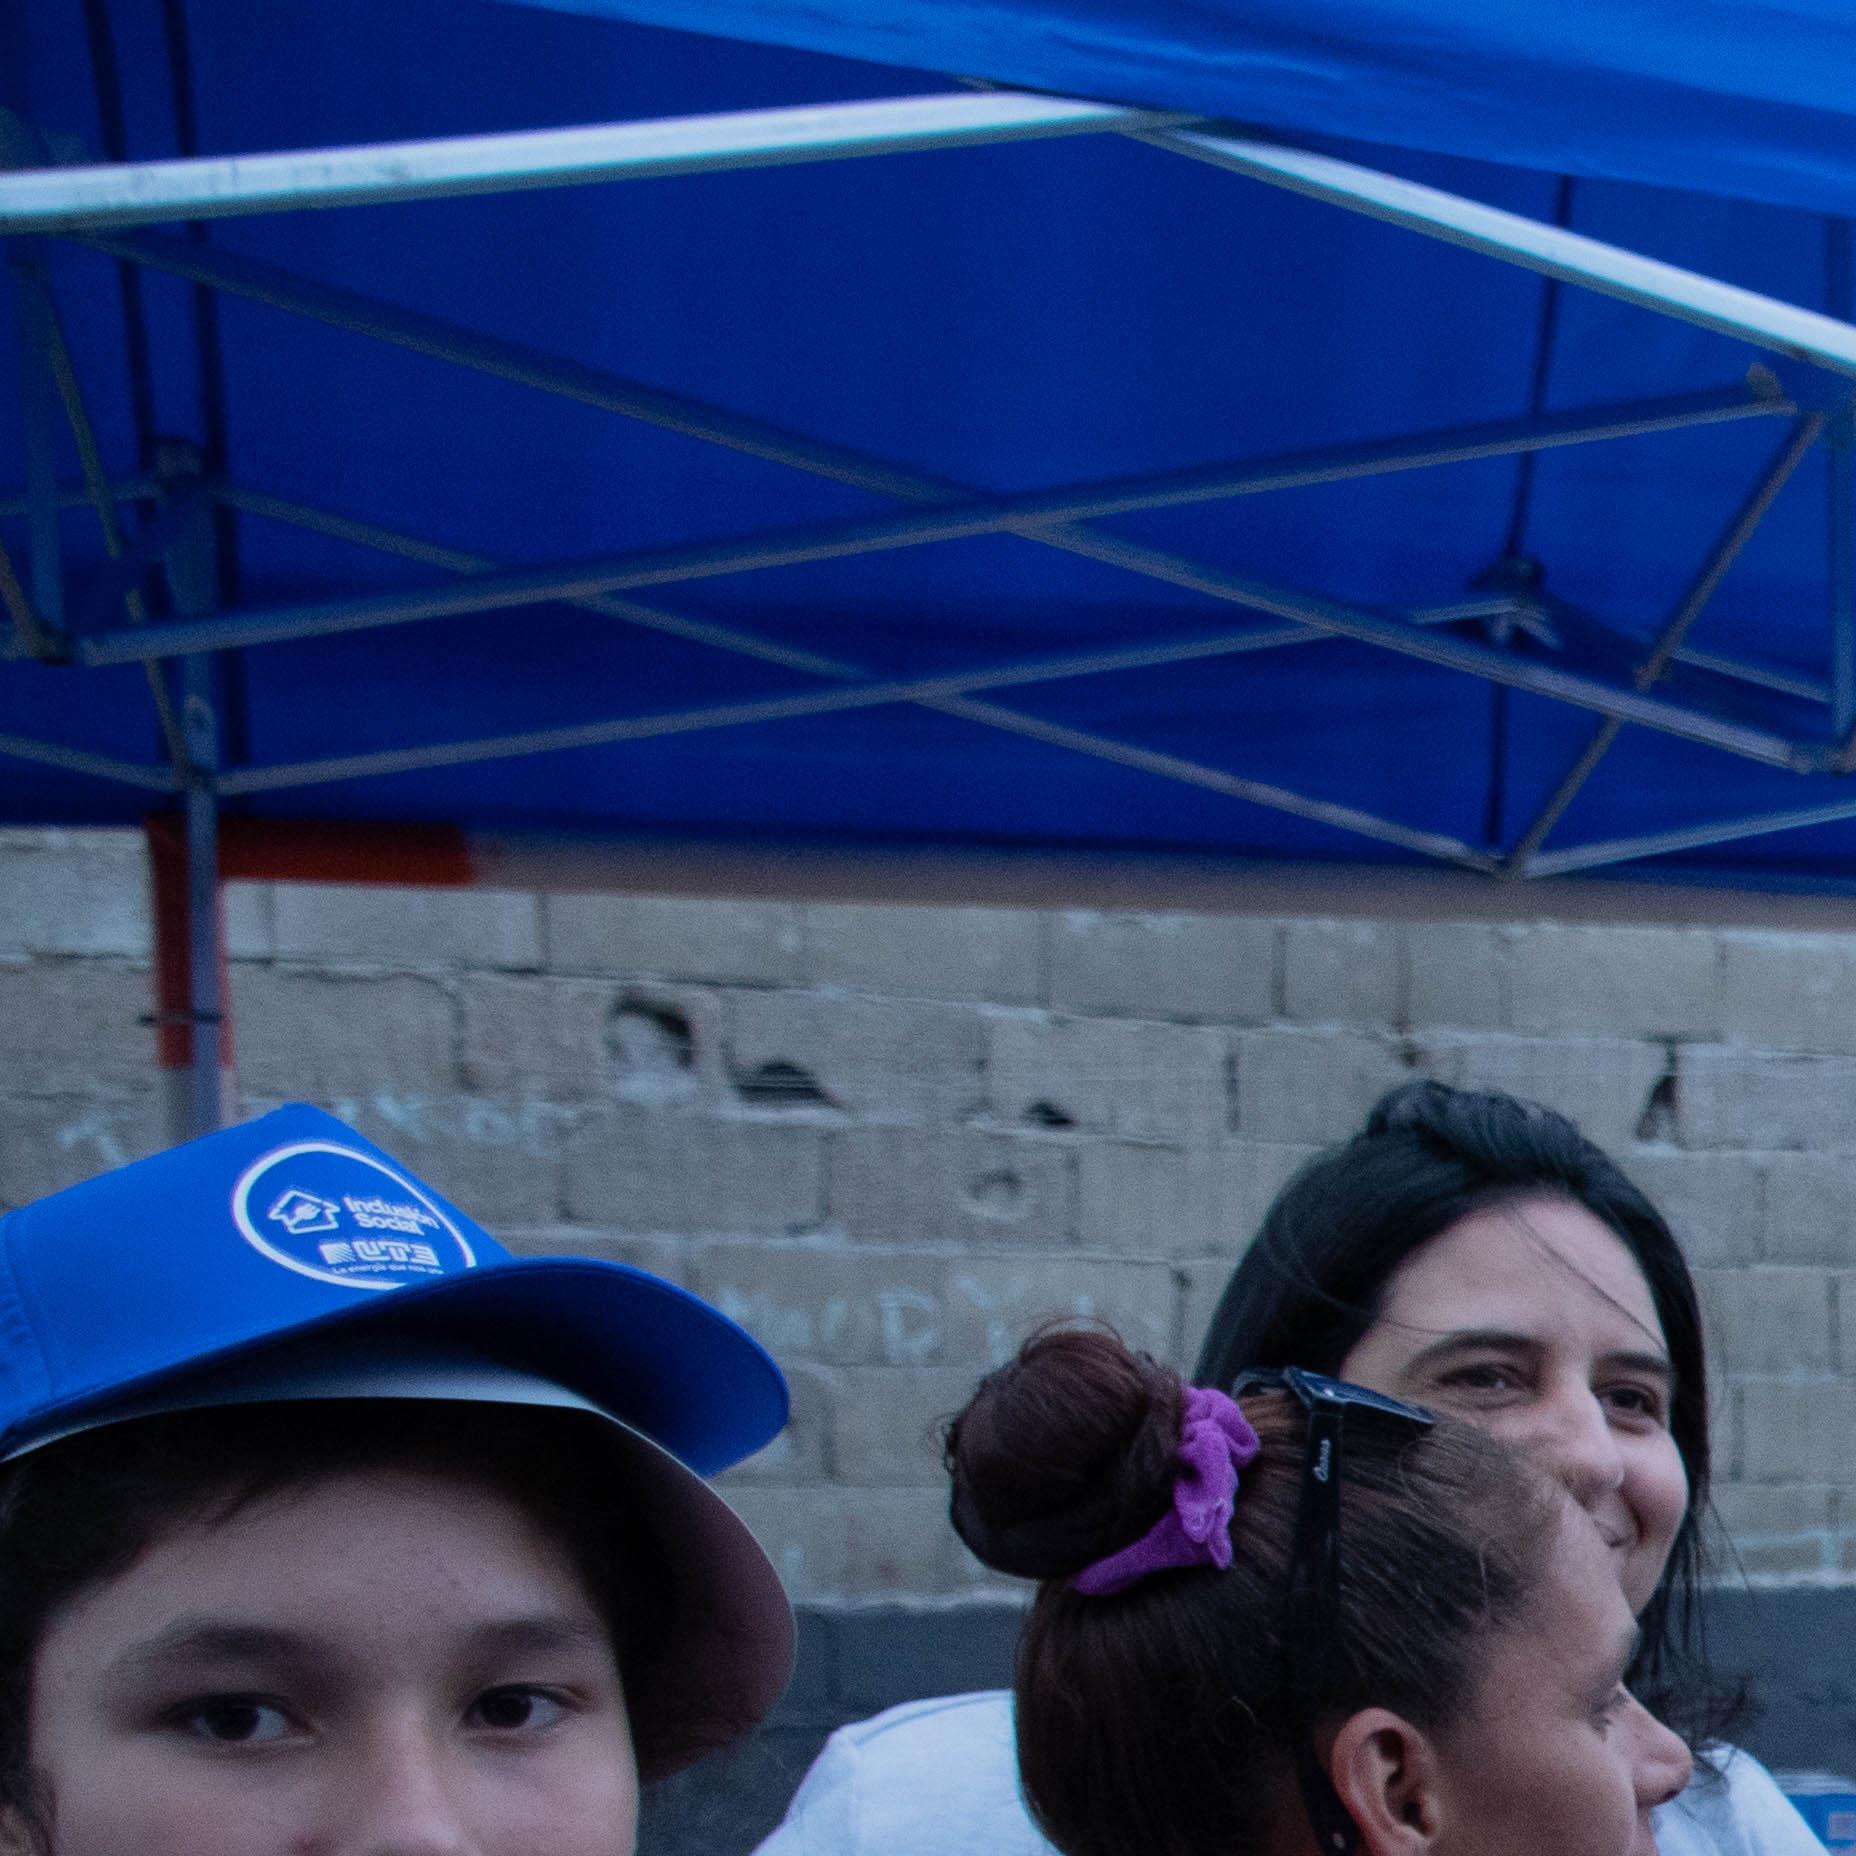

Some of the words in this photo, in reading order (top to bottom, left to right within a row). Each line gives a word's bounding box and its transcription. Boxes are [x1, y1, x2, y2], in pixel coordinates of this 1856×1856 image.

[343, 1194, 440, 1230] Inclusión
[353, 1212, 425, 1236] Social
[351, 1240, 441, 1267] UTE
